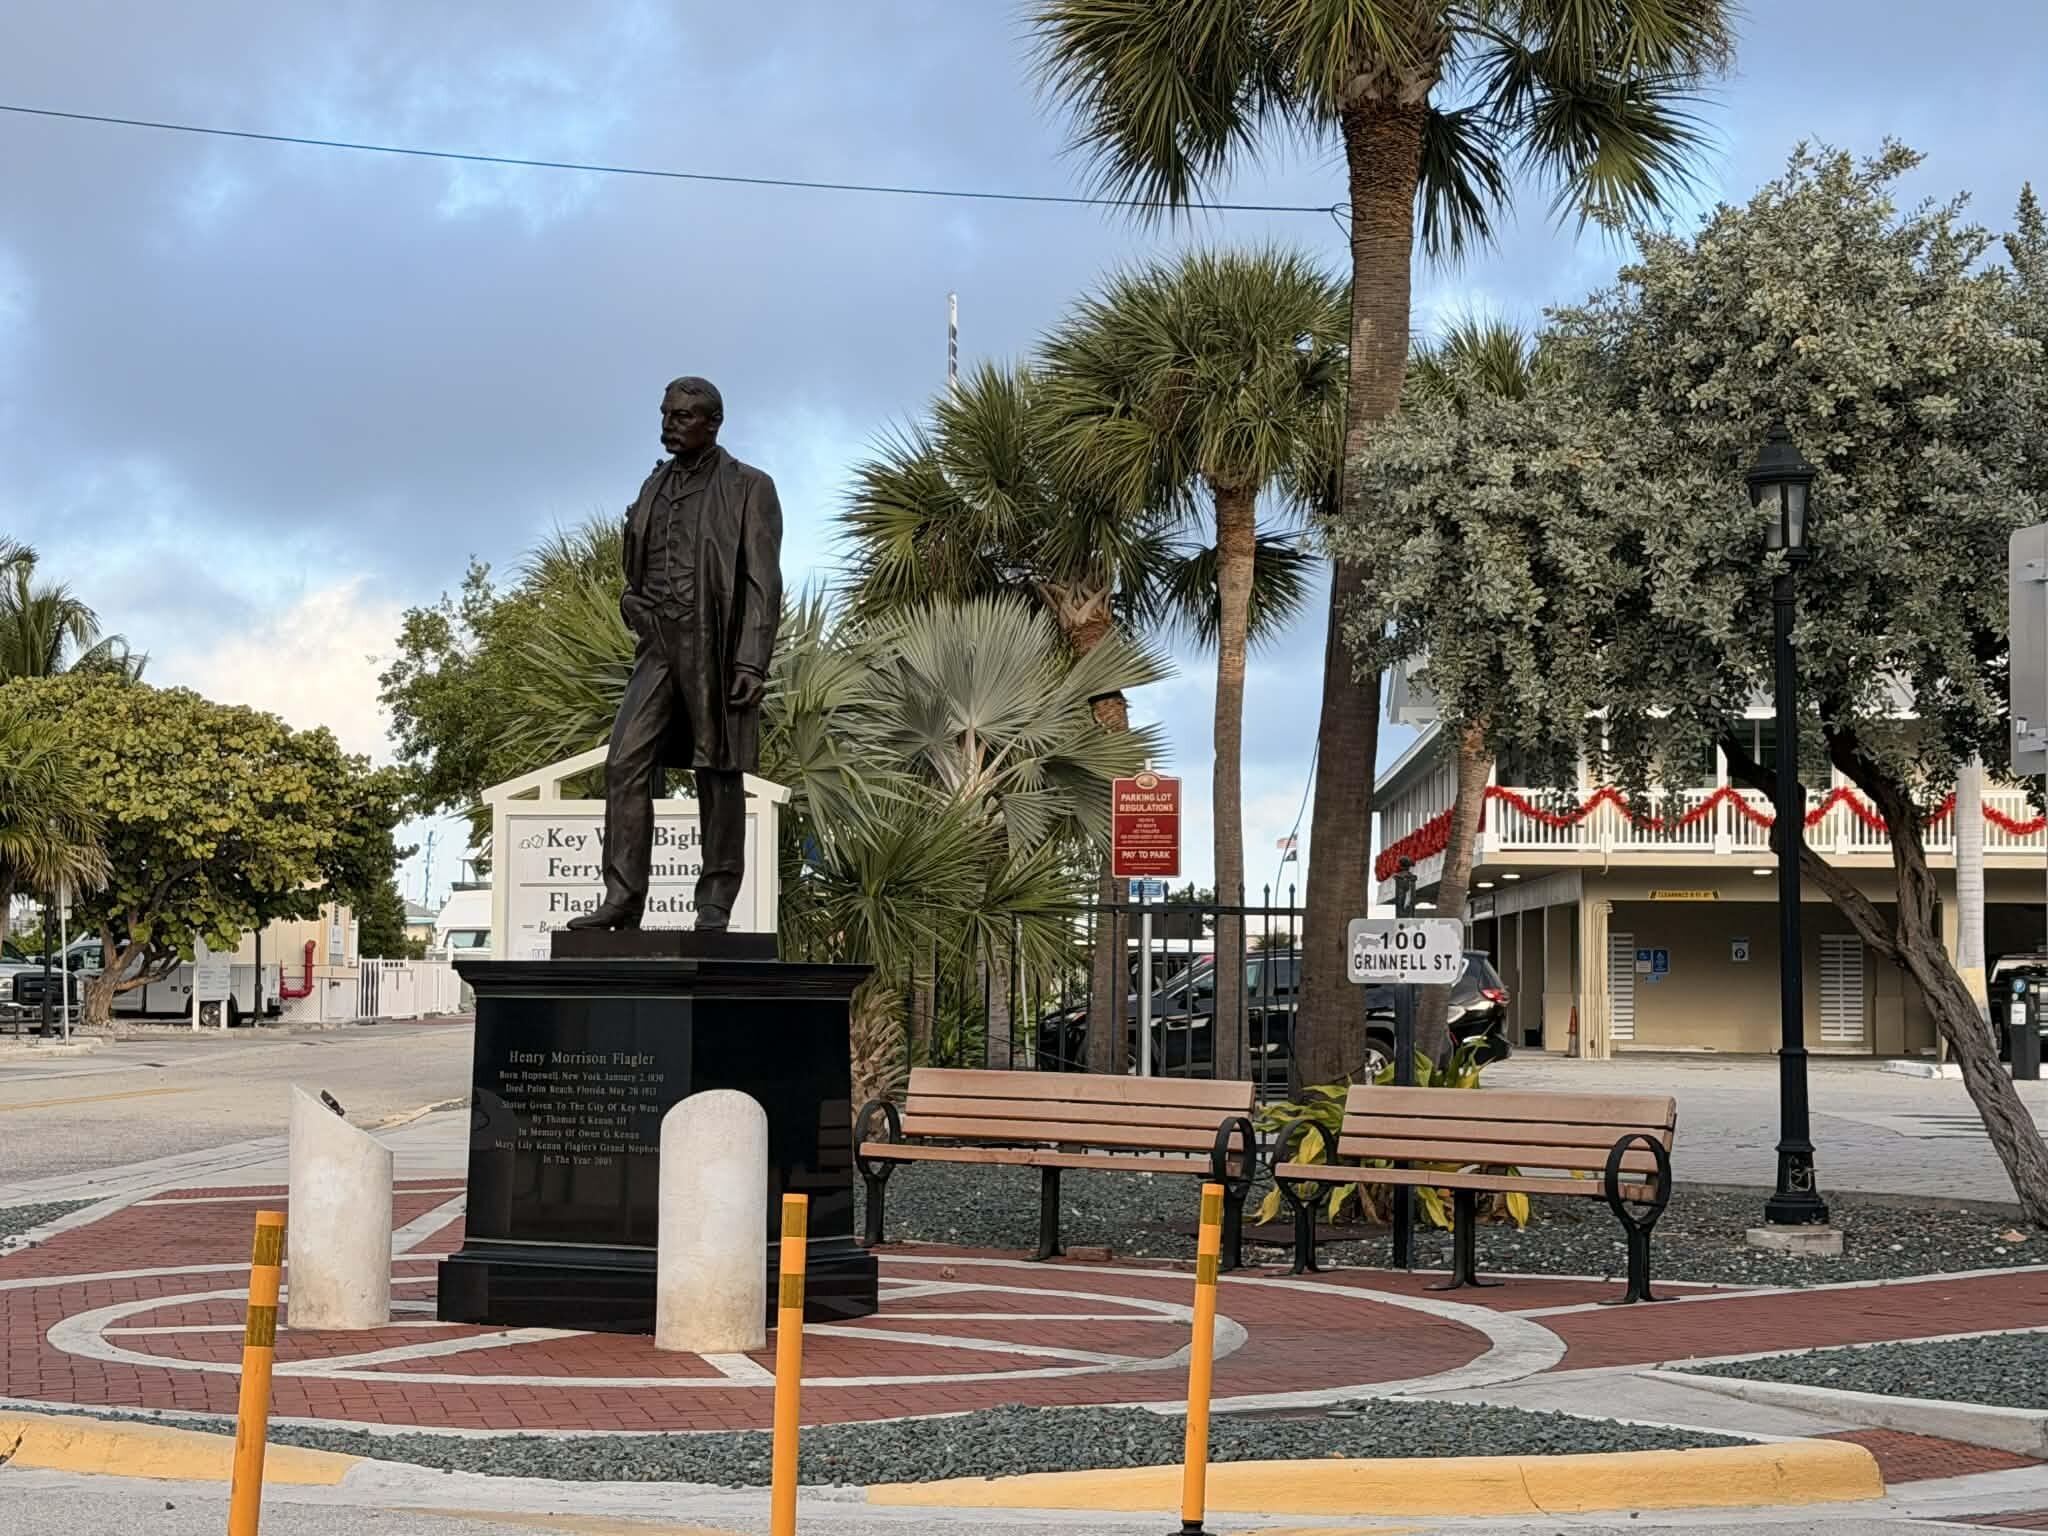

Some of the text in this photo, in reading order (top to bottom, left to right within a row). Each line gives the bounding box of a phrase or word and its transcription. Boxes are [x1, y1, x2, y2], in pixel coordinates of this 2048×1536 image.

[1121, 793, 1154, 801] PARKING
[1119, 804, 1174, 812] REGULATIONS
[547, 827, 588, 851] Key
[654, 826, 703, 850] Bigh
[1121, 851, 1170, 859] PAY TO PARK
[549, 857, 601, 881] Ferry
[549, 892, 696, 917] Flagl tatio
[1380, 932, 1426, 949] 100
[1354, 954, 1456, 970] GRINNELL ST.
[509, 1050, 656, 1067] Henry Morrison Flagler
[556, 1102, 567, 1111] To
[569, 1102, 584, 1111] The
[587, 1103, 604, 1113] City
[620, 1104, 636, 1114] Key
[639, 1104, 658, 1113] West
